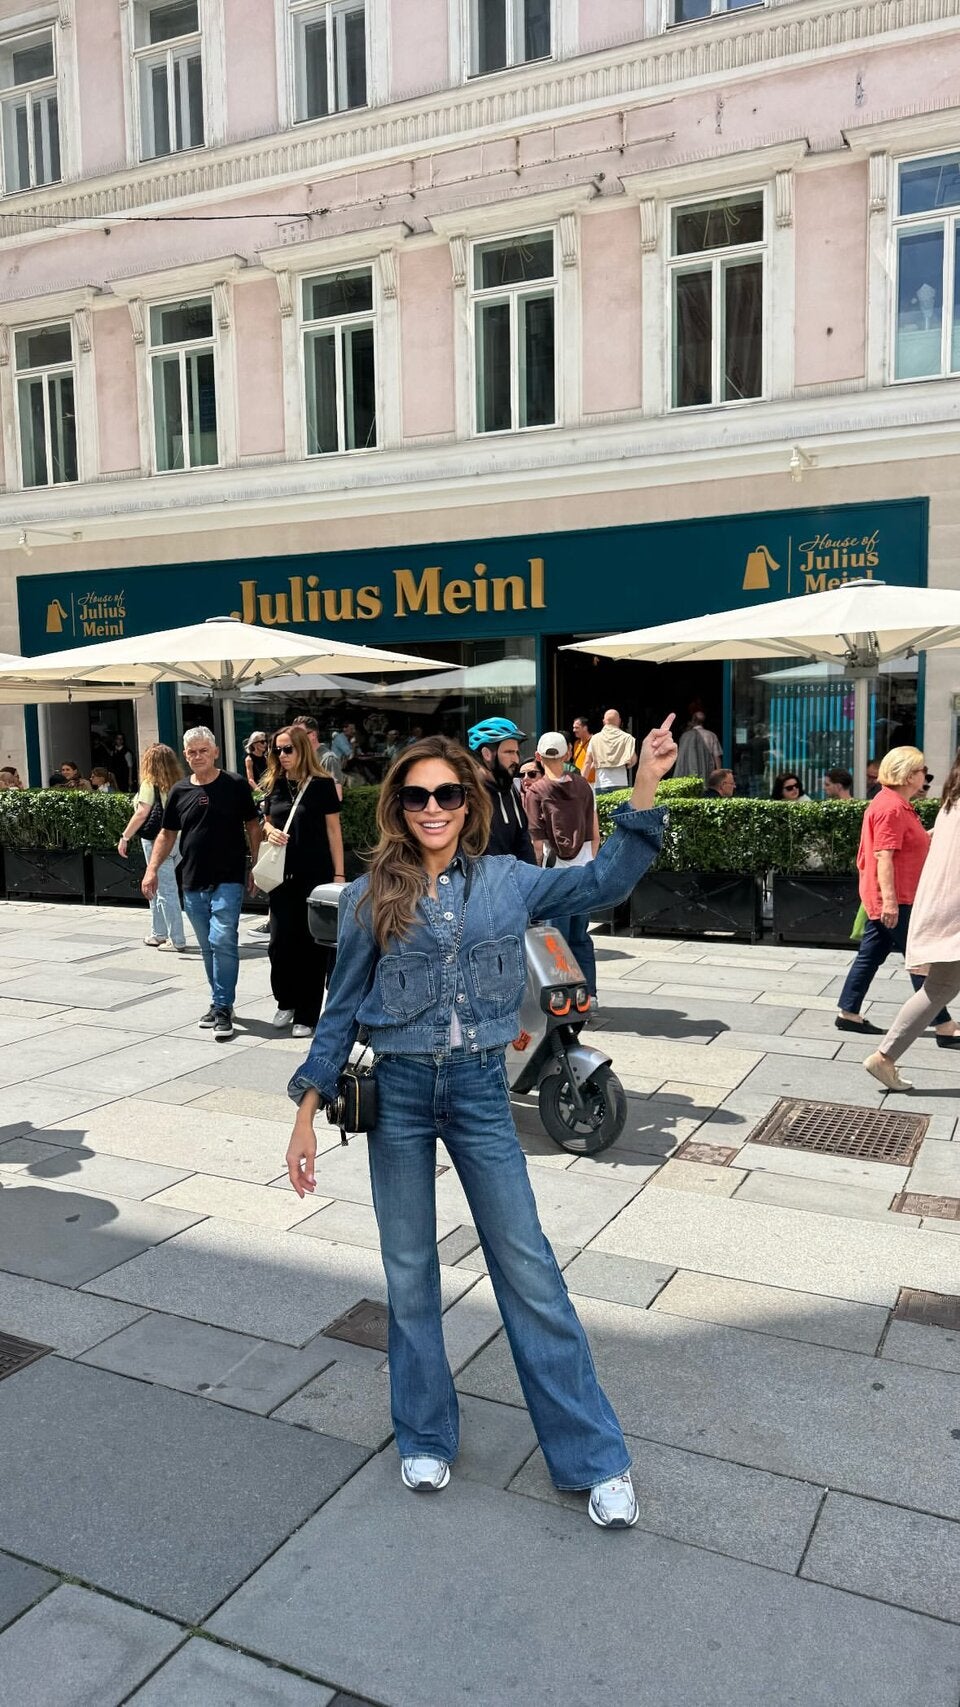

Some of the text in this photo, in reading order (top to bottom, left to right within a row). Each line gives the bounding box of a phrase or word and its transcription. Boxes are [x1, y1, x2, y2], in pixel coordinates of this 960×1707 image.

[799, 530, 880, 553] House of
[800, 548, 879, 571] Julius
[78, 590, 126, 607] House of
[229, 557, 547, 625] Julius Meinl
[80, 603, 126, 620] Julius
[83, 620, 123, 637] Meinl
